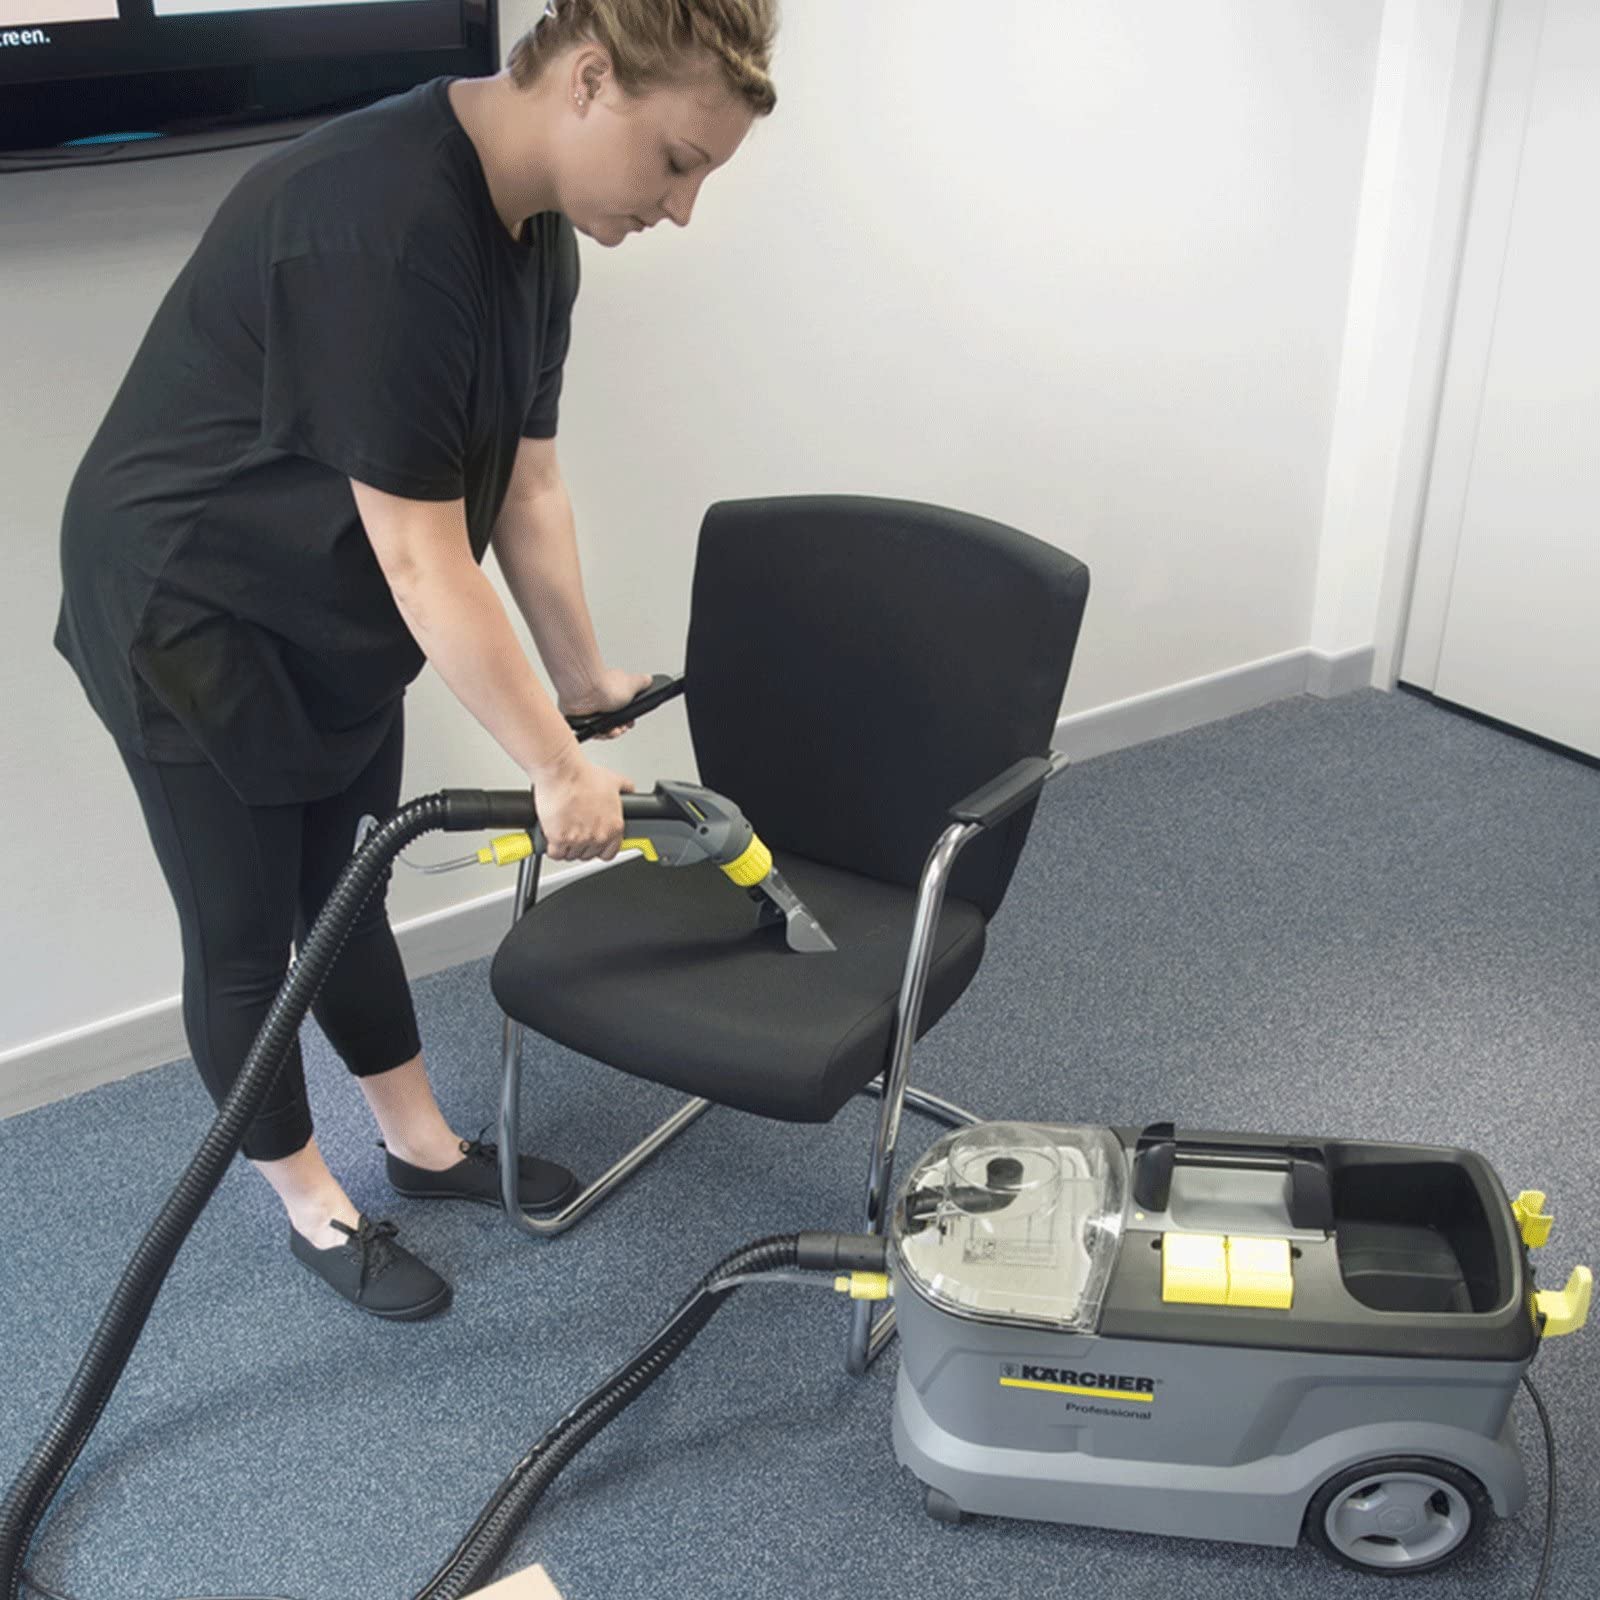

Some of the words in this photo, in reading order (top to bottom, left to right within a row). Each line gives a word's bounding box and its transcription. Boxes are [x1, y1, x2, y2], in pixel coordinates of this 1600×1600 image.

[0, 28, 51, 47] reen.
[1022, 1364, 1155, 1392] KÄRCHER
[1066, 1402, 1152, 1420] Professional
